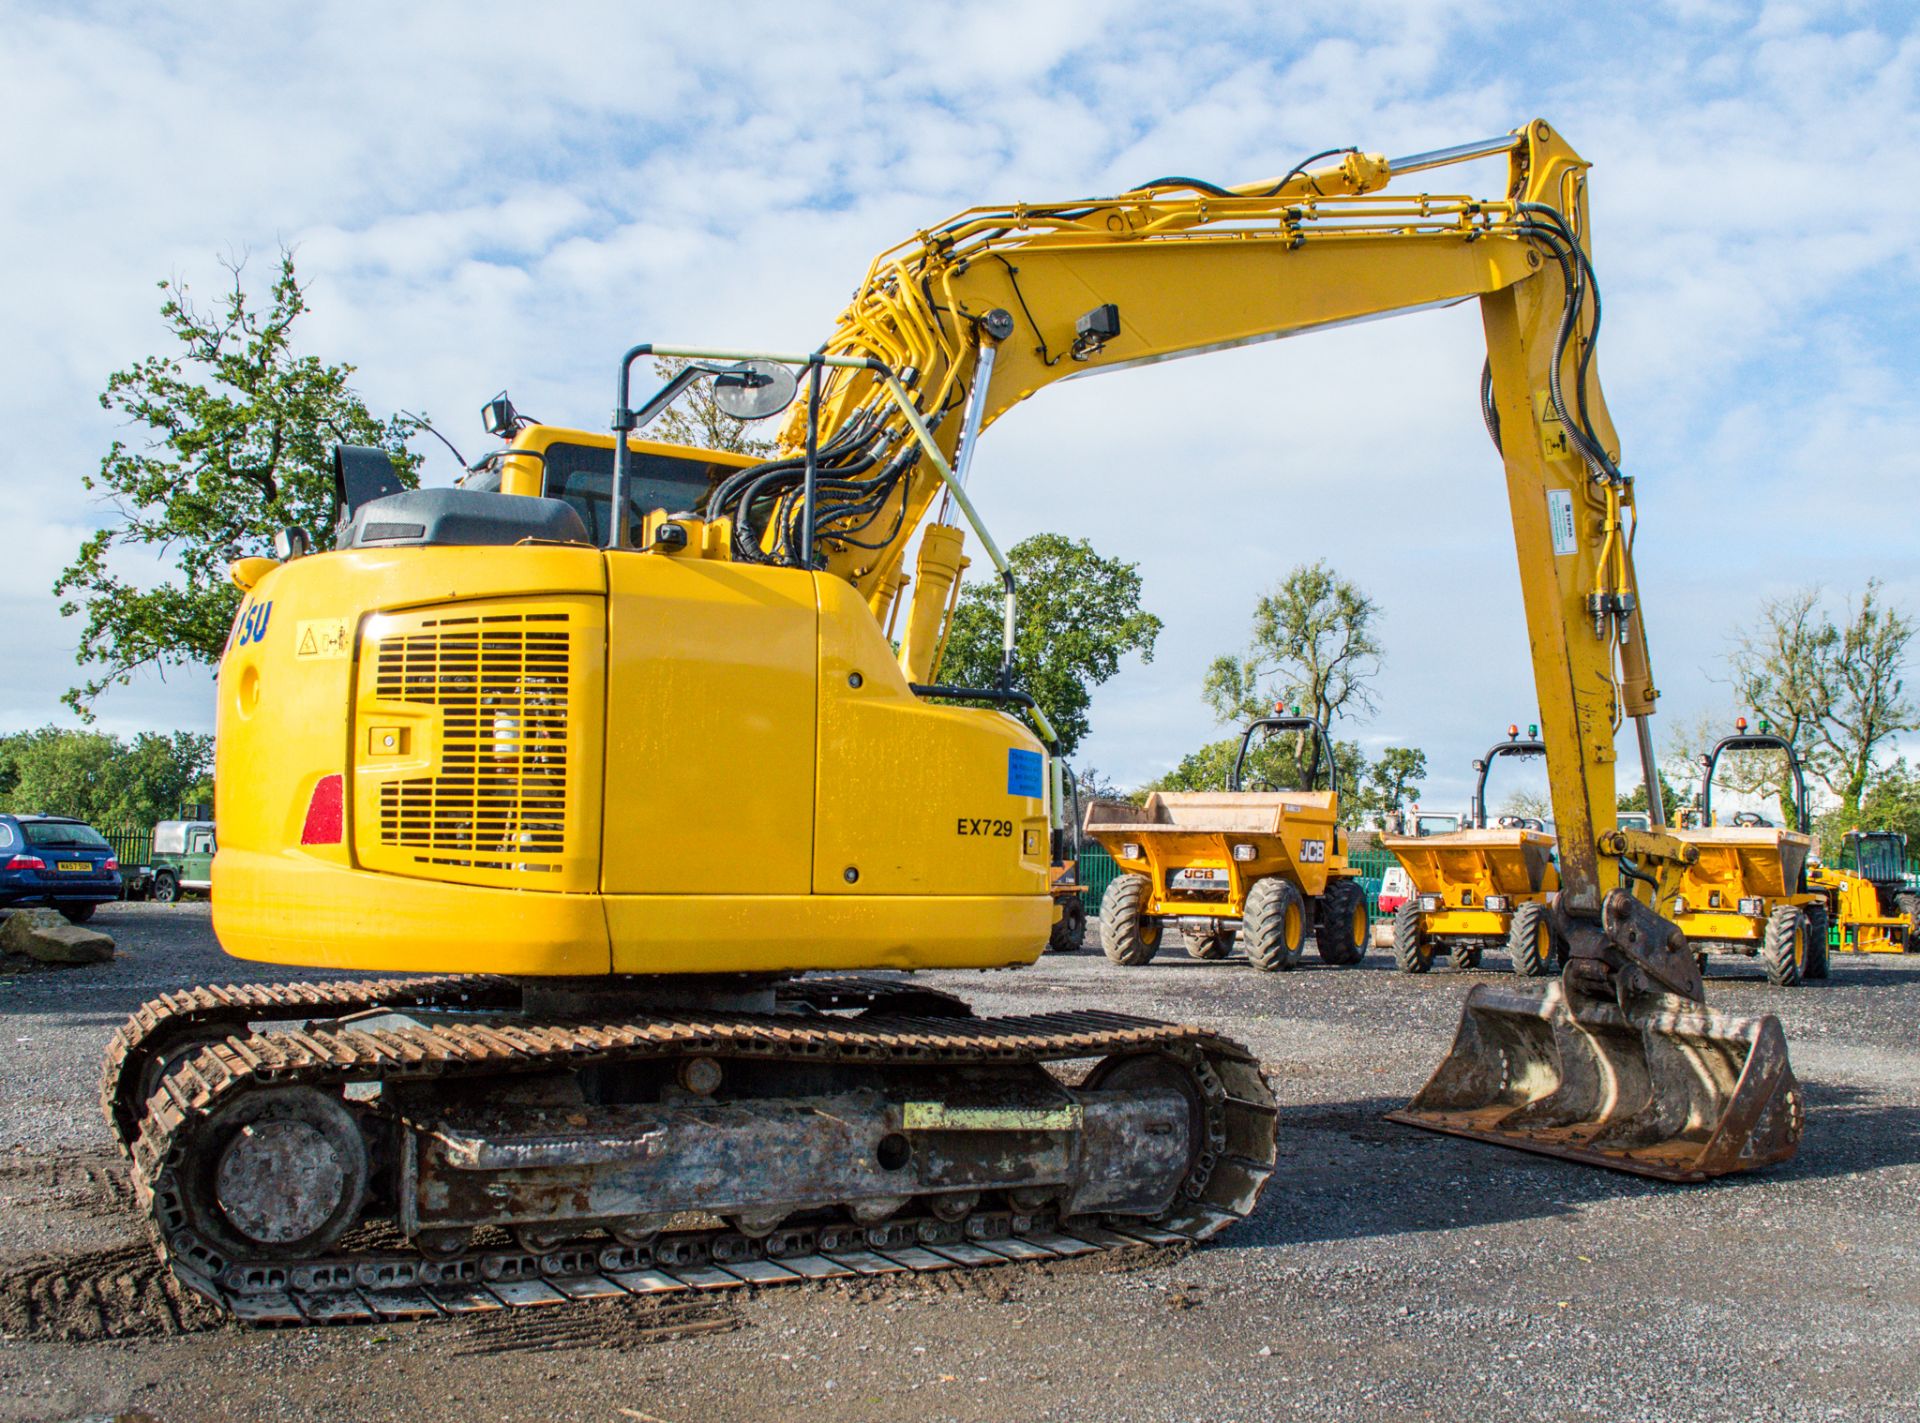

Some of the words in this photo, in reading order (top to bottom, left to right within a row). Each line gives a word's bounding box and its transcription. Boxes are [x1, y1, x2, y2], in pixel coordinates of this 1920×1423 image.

[957, 818, 1013, 838] EX729
[1300, 840, 1325, 862] JCB
[1184, 869, 1214, 880] JCB
